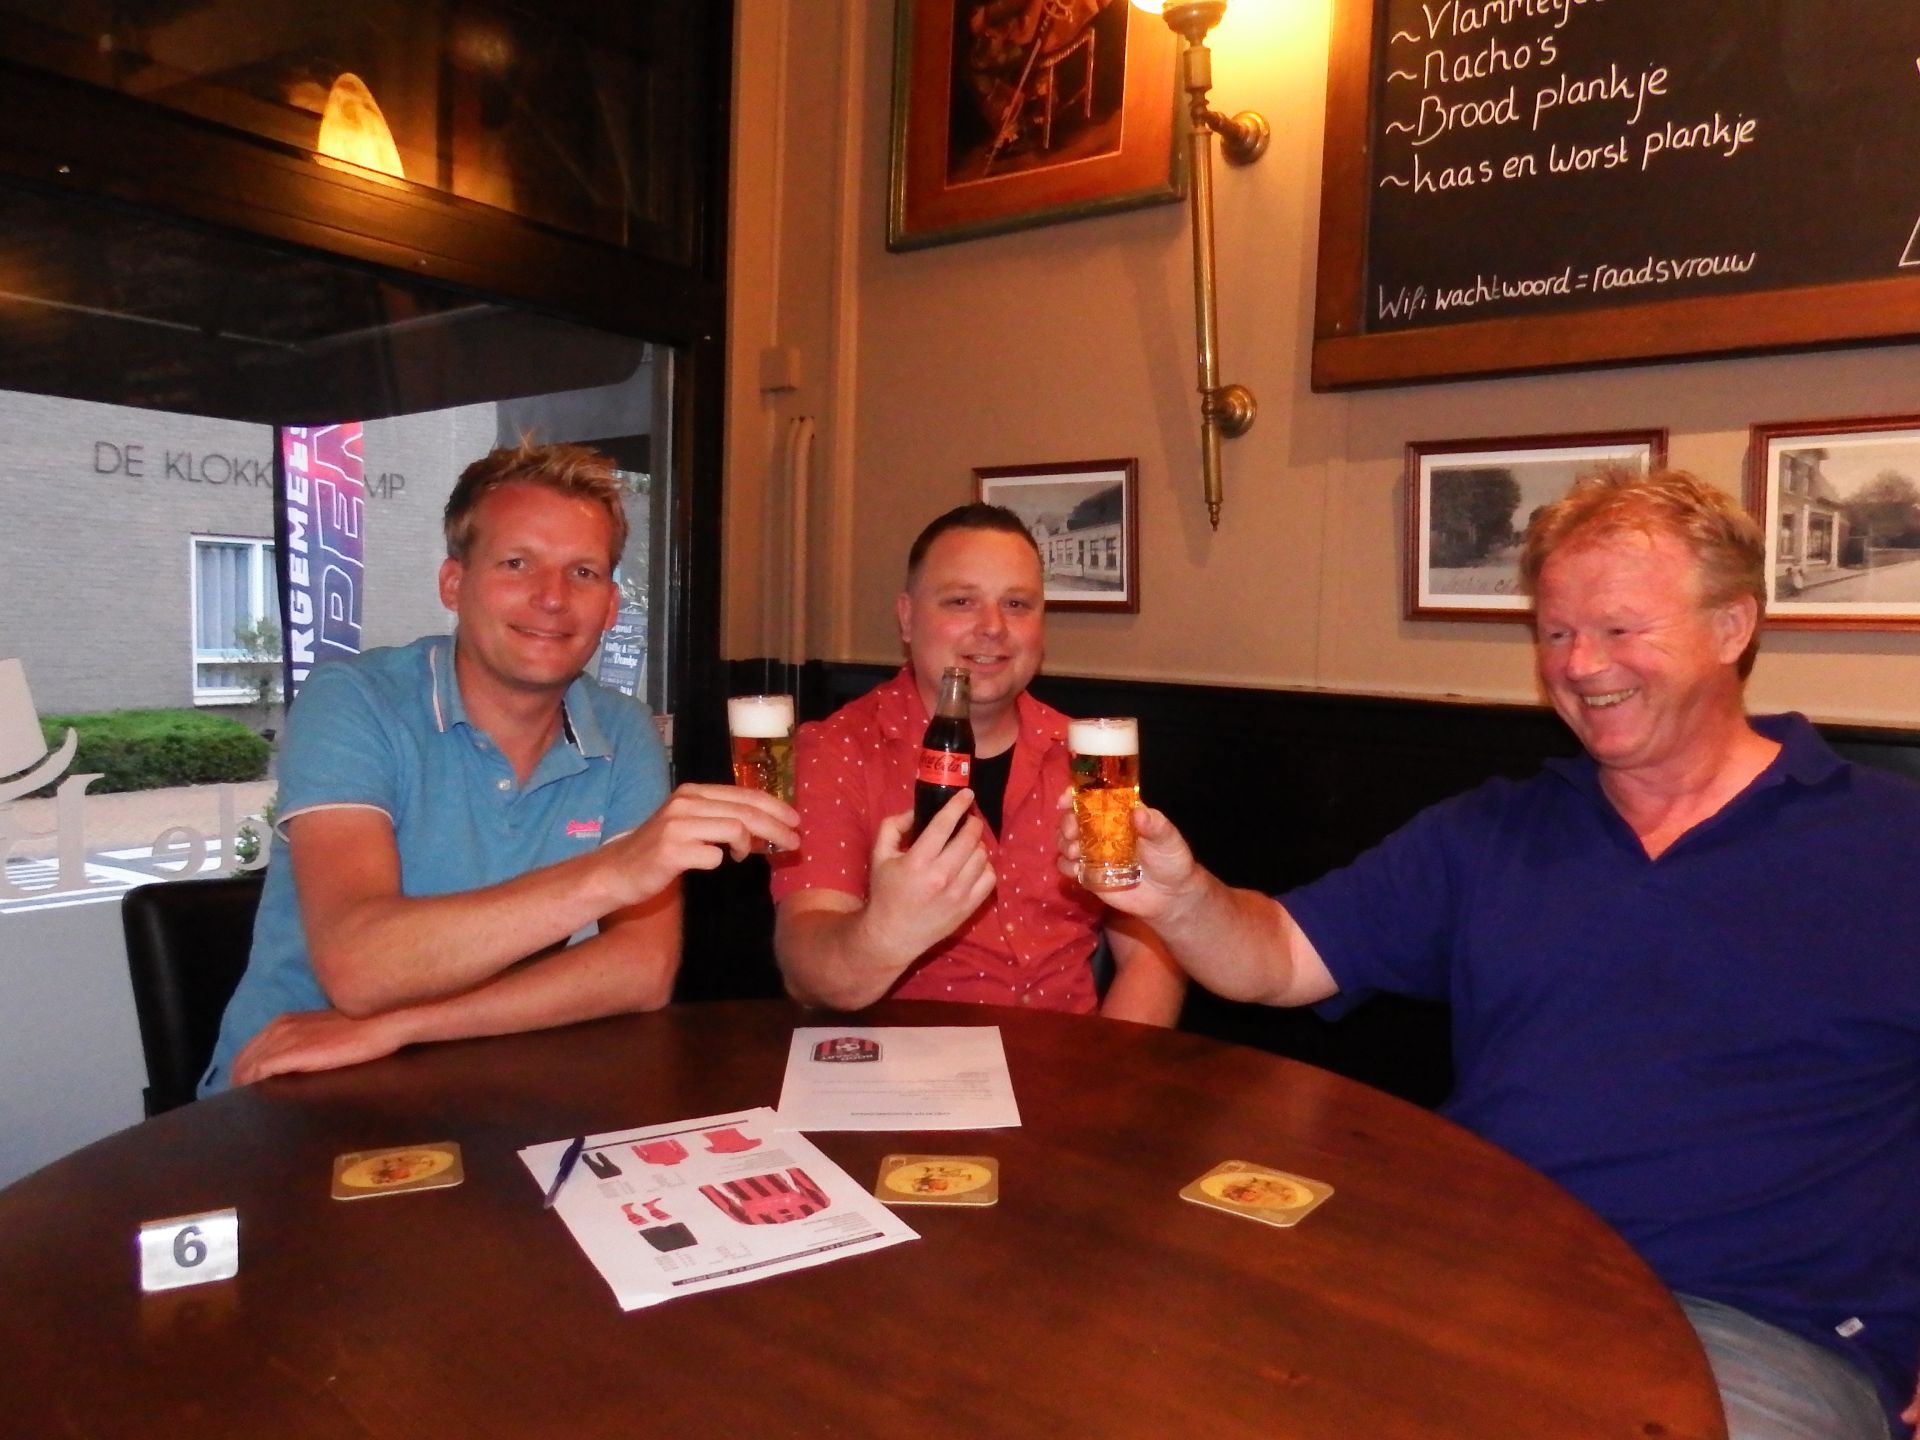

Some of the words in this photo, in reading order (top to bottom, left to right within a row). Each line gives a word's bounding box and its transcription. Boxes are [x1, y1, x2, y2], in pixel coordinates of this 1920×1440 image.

[1411, 85, 1520, 146] Brood
[1532, 62, 1669, 131] plankje
[1502, 154, 1537, 179] en
[1641, 111, 1757, 172] plankje
[93, 440, 145, 478] DE
[172, 1225, 208, 1269] 6
